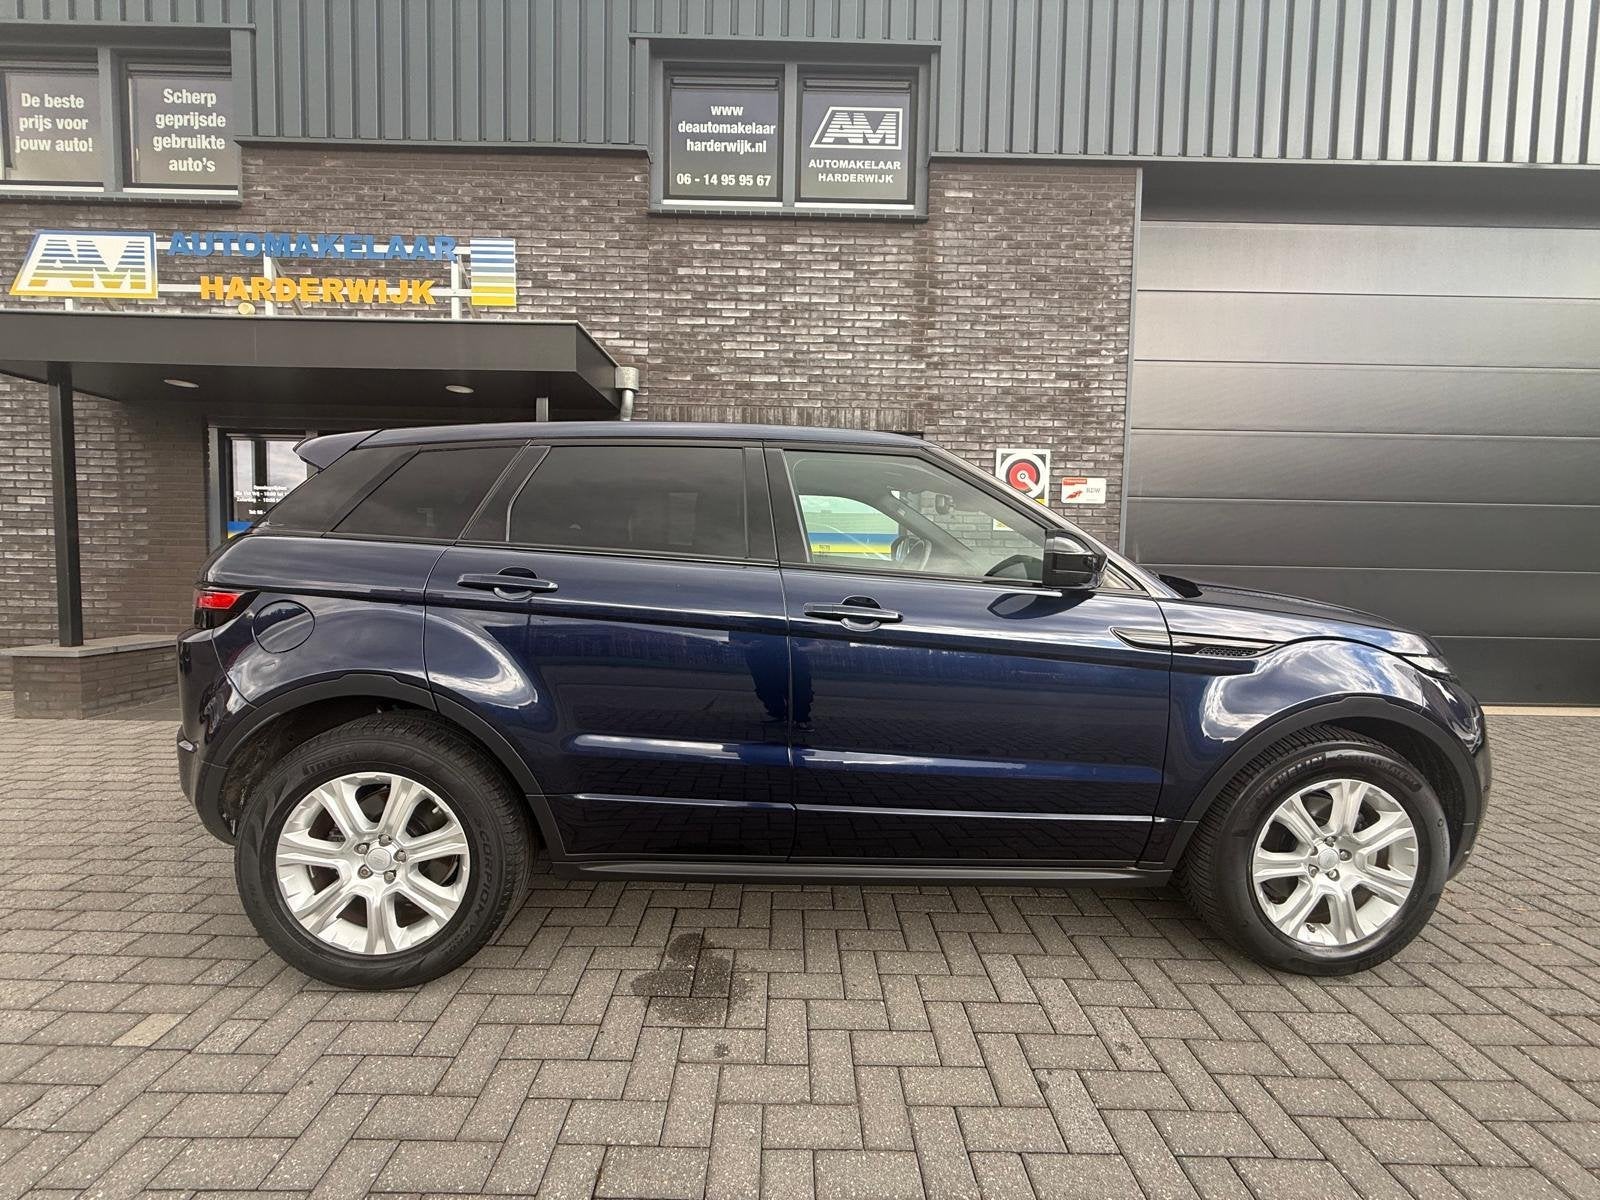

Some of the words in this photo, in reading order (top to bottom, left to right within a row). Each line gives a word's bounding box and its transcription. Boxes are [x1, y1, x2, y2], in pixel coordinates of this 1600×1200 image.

[21, 93, 41, 108] De
[44, 93, 85, 109] beste
[163, 88, 217, 107] Scherp
[710, 105, 744, 116] www
[19, 114, 52, 132] prijs
[55, 118, 89, 130] voor
[155, 112, 226, 130] geprijsde
[677, 121, 776, 136] deautomakelaar
[15, 135, 51, 154] jouw
[55, 137, 93, 152] auto!
[153, 133, 226, 152] gebruikte
[686, 138, 767, 155] harderwijk.nl
[168, 157, 216, 173] auto's
[808, 159, 902, 171] AUTOMAKELAAR
[676, 173, 692, 185] 06
[703, 174, 718, 186] 14
[720, 174, 736, 187] 95
[738, 175, 754, 187] 95
[756, 175, 772, 187] 67
[818, 173, 894, 184] HARDERWIJK
[168, 231, 457, 262] AUTOMAKELAAR
[200, 275, 436, 305] HARDERWIJK
